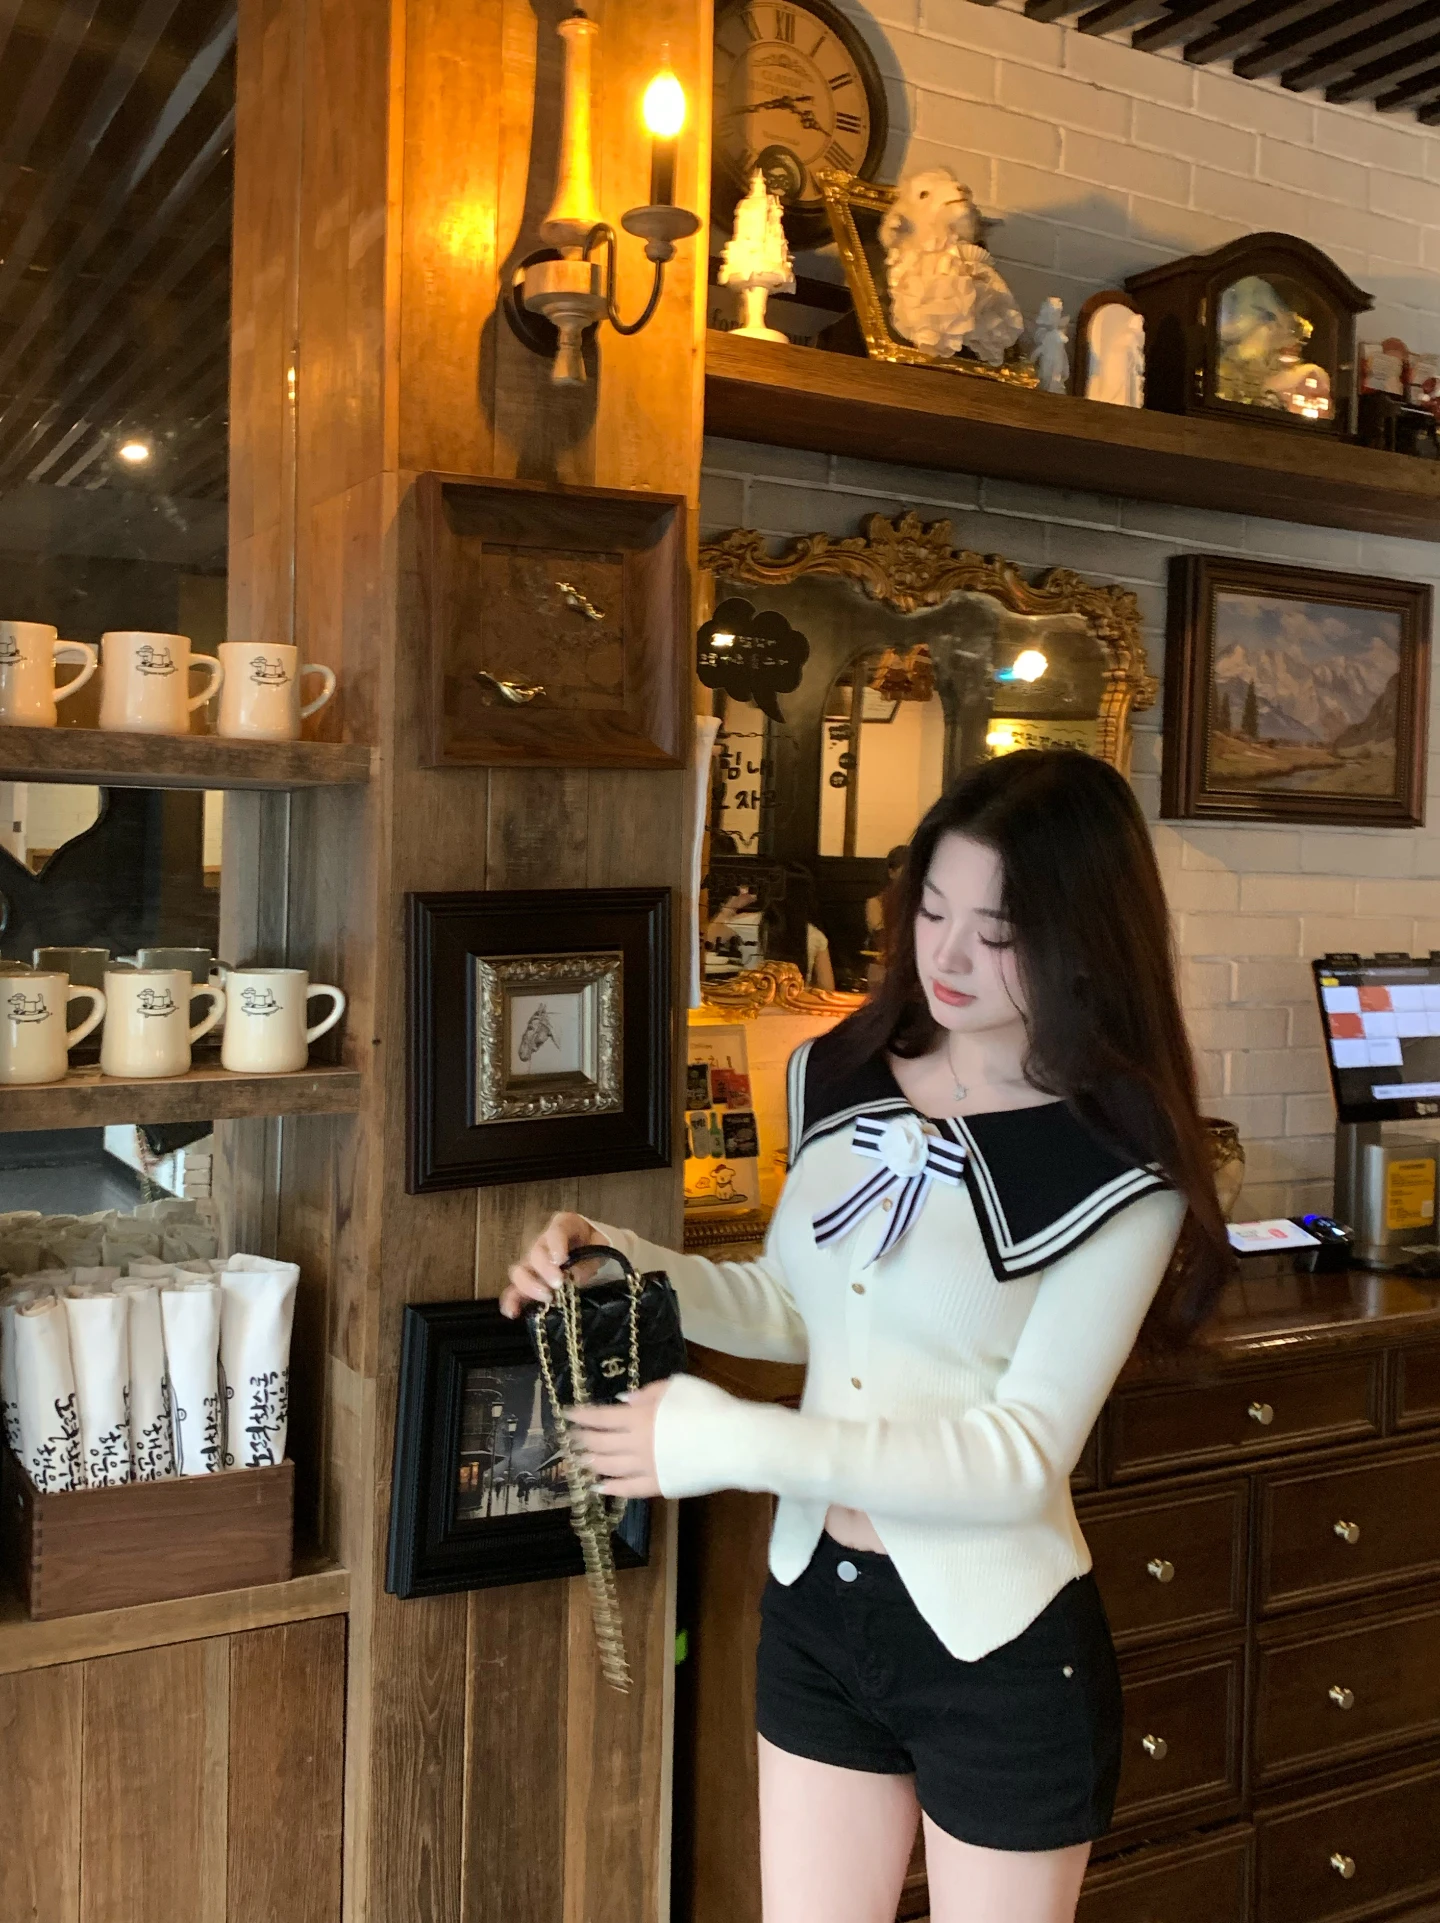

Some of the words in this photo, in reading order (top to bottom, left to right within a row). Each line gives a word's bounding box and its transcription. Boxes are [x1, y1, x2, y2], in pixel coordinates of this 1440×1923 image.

[776, 9, 796, 44] XII
[828, 72, 854, 91] II
[835, 111, 862, 134] III
